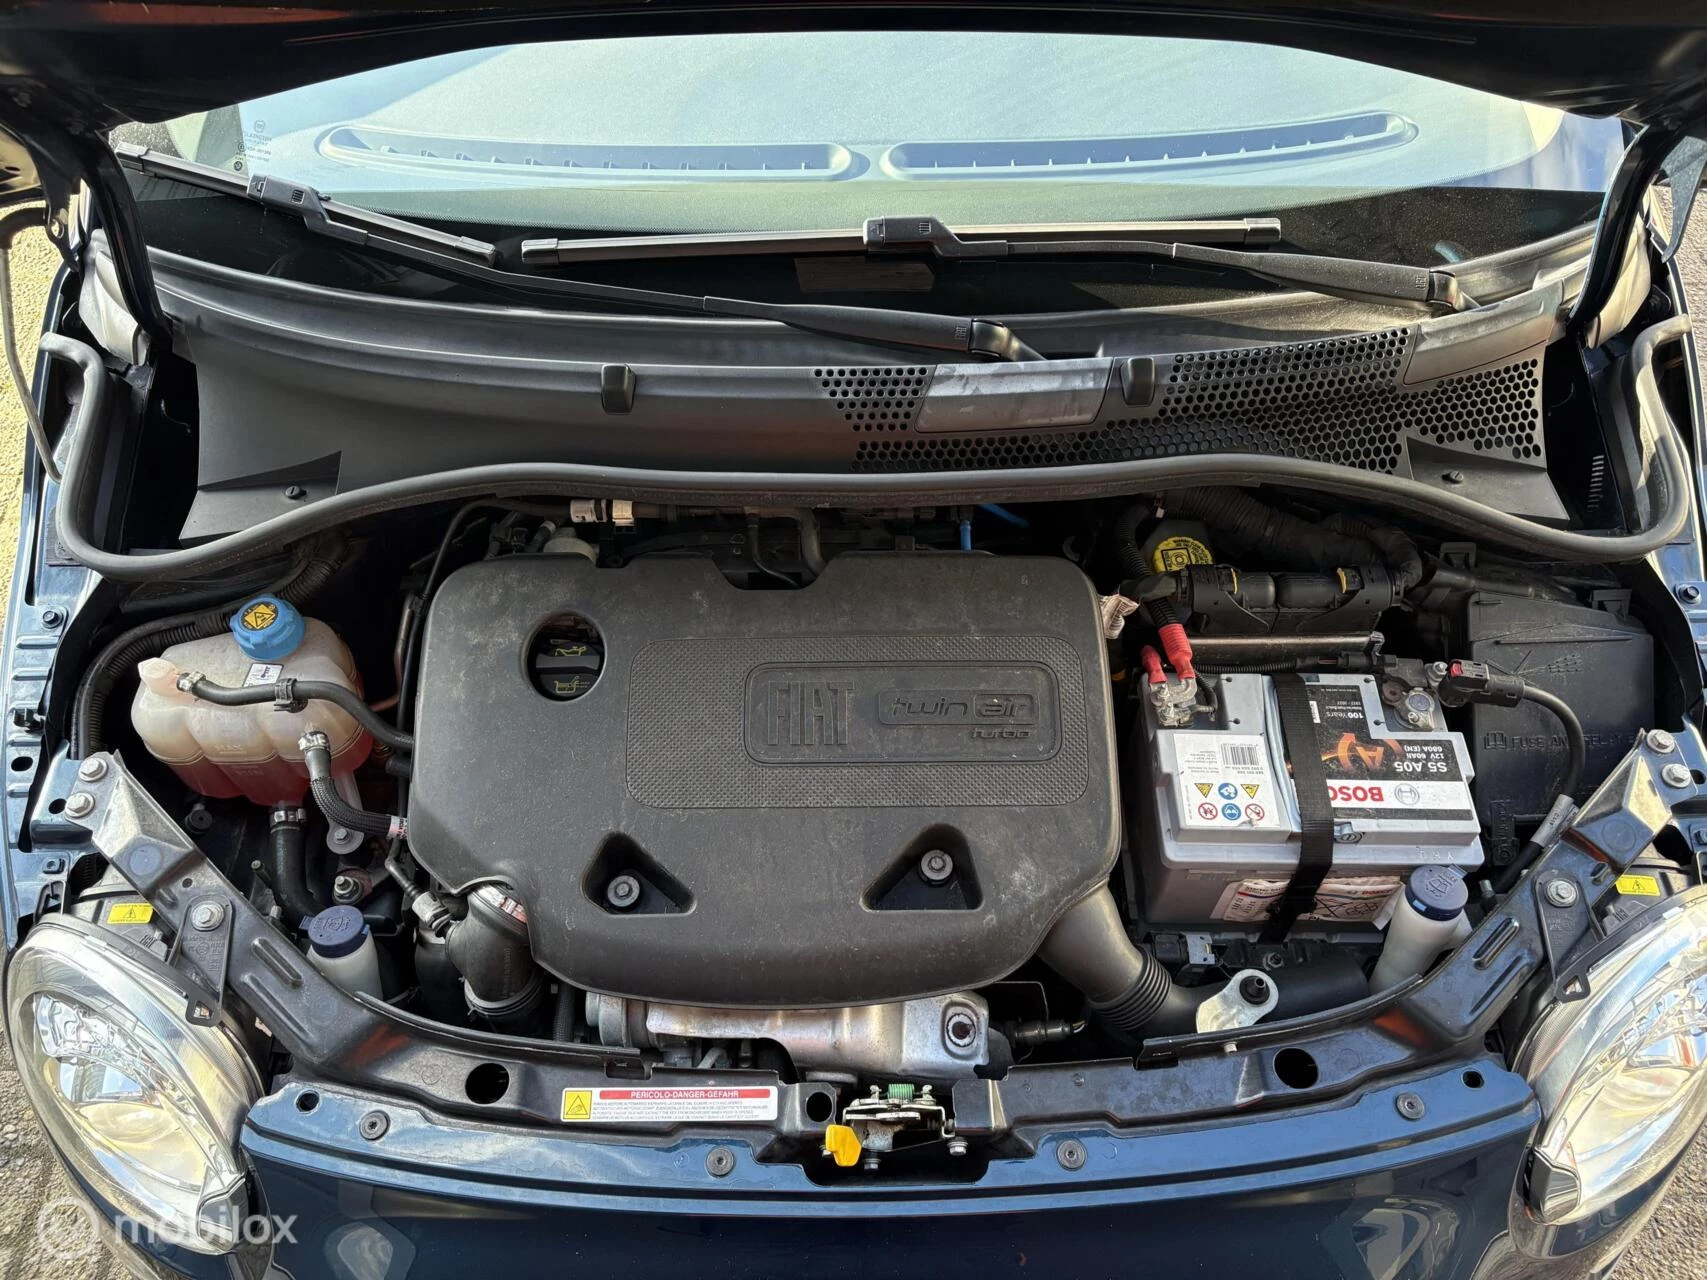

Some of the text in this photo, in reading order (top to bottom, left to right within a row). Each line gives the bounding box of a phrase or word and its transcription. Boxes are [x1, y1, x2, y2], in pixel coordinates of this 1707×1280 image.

[767, 681, 855, 746] FIAT
[890, 697, 969, 718] twin
[971, 727, 1032, 739] turbo
[1511, 736, 1546, 748] FUSE
[1550, 735, 1571, 749] AN
[1393, 761, 1448, 772] S5 A05
[1327, 785, 1385, 802] BOSC
[630, 1089, 739, 1100] PERICOLO-DANGER-GEFAHR
